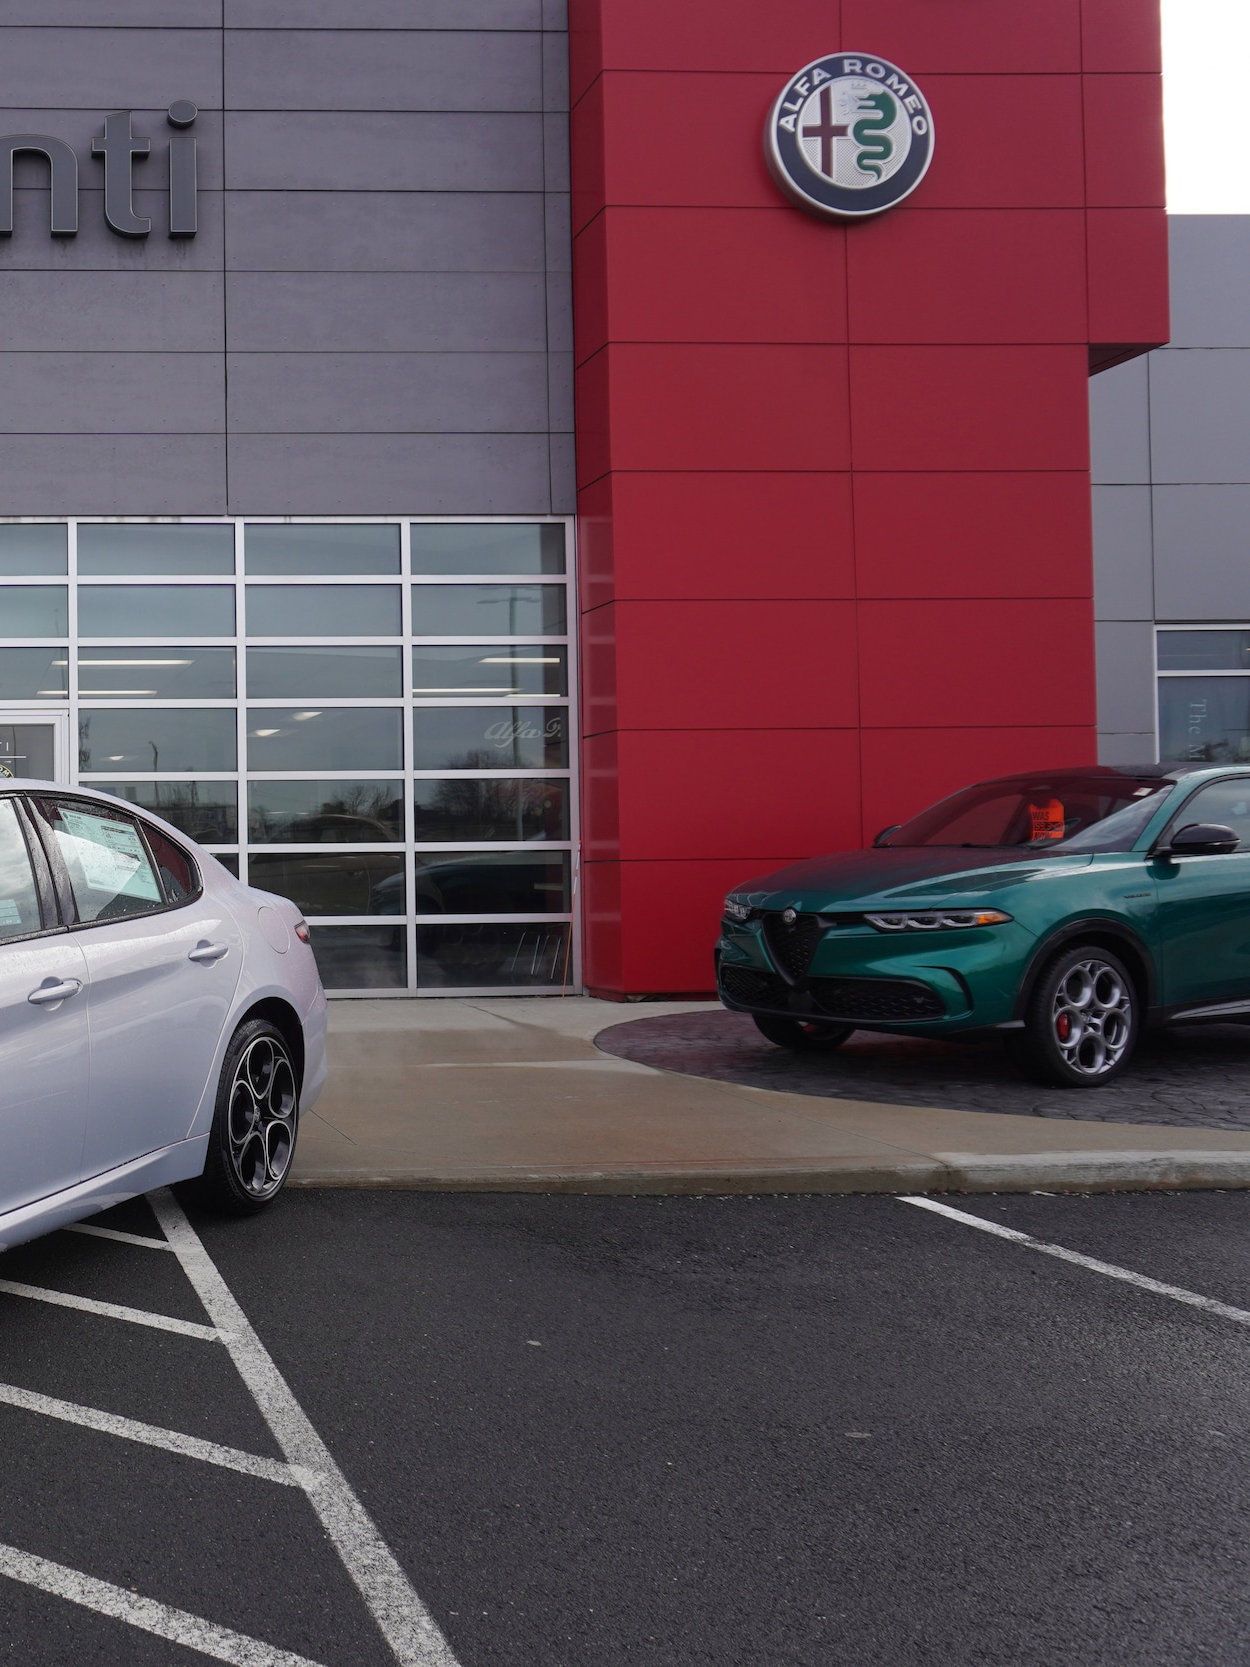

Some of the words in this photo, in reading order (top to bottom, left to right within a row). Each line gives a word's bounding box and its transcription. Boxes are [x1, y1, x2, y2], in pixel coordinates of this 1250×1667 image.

[779, 67, 832, 133] ALFA
[843, 58, 928, 136] ROMEO
[484, 720, 542, 748] Alfa
[1189, 699, 1207, 734] The
